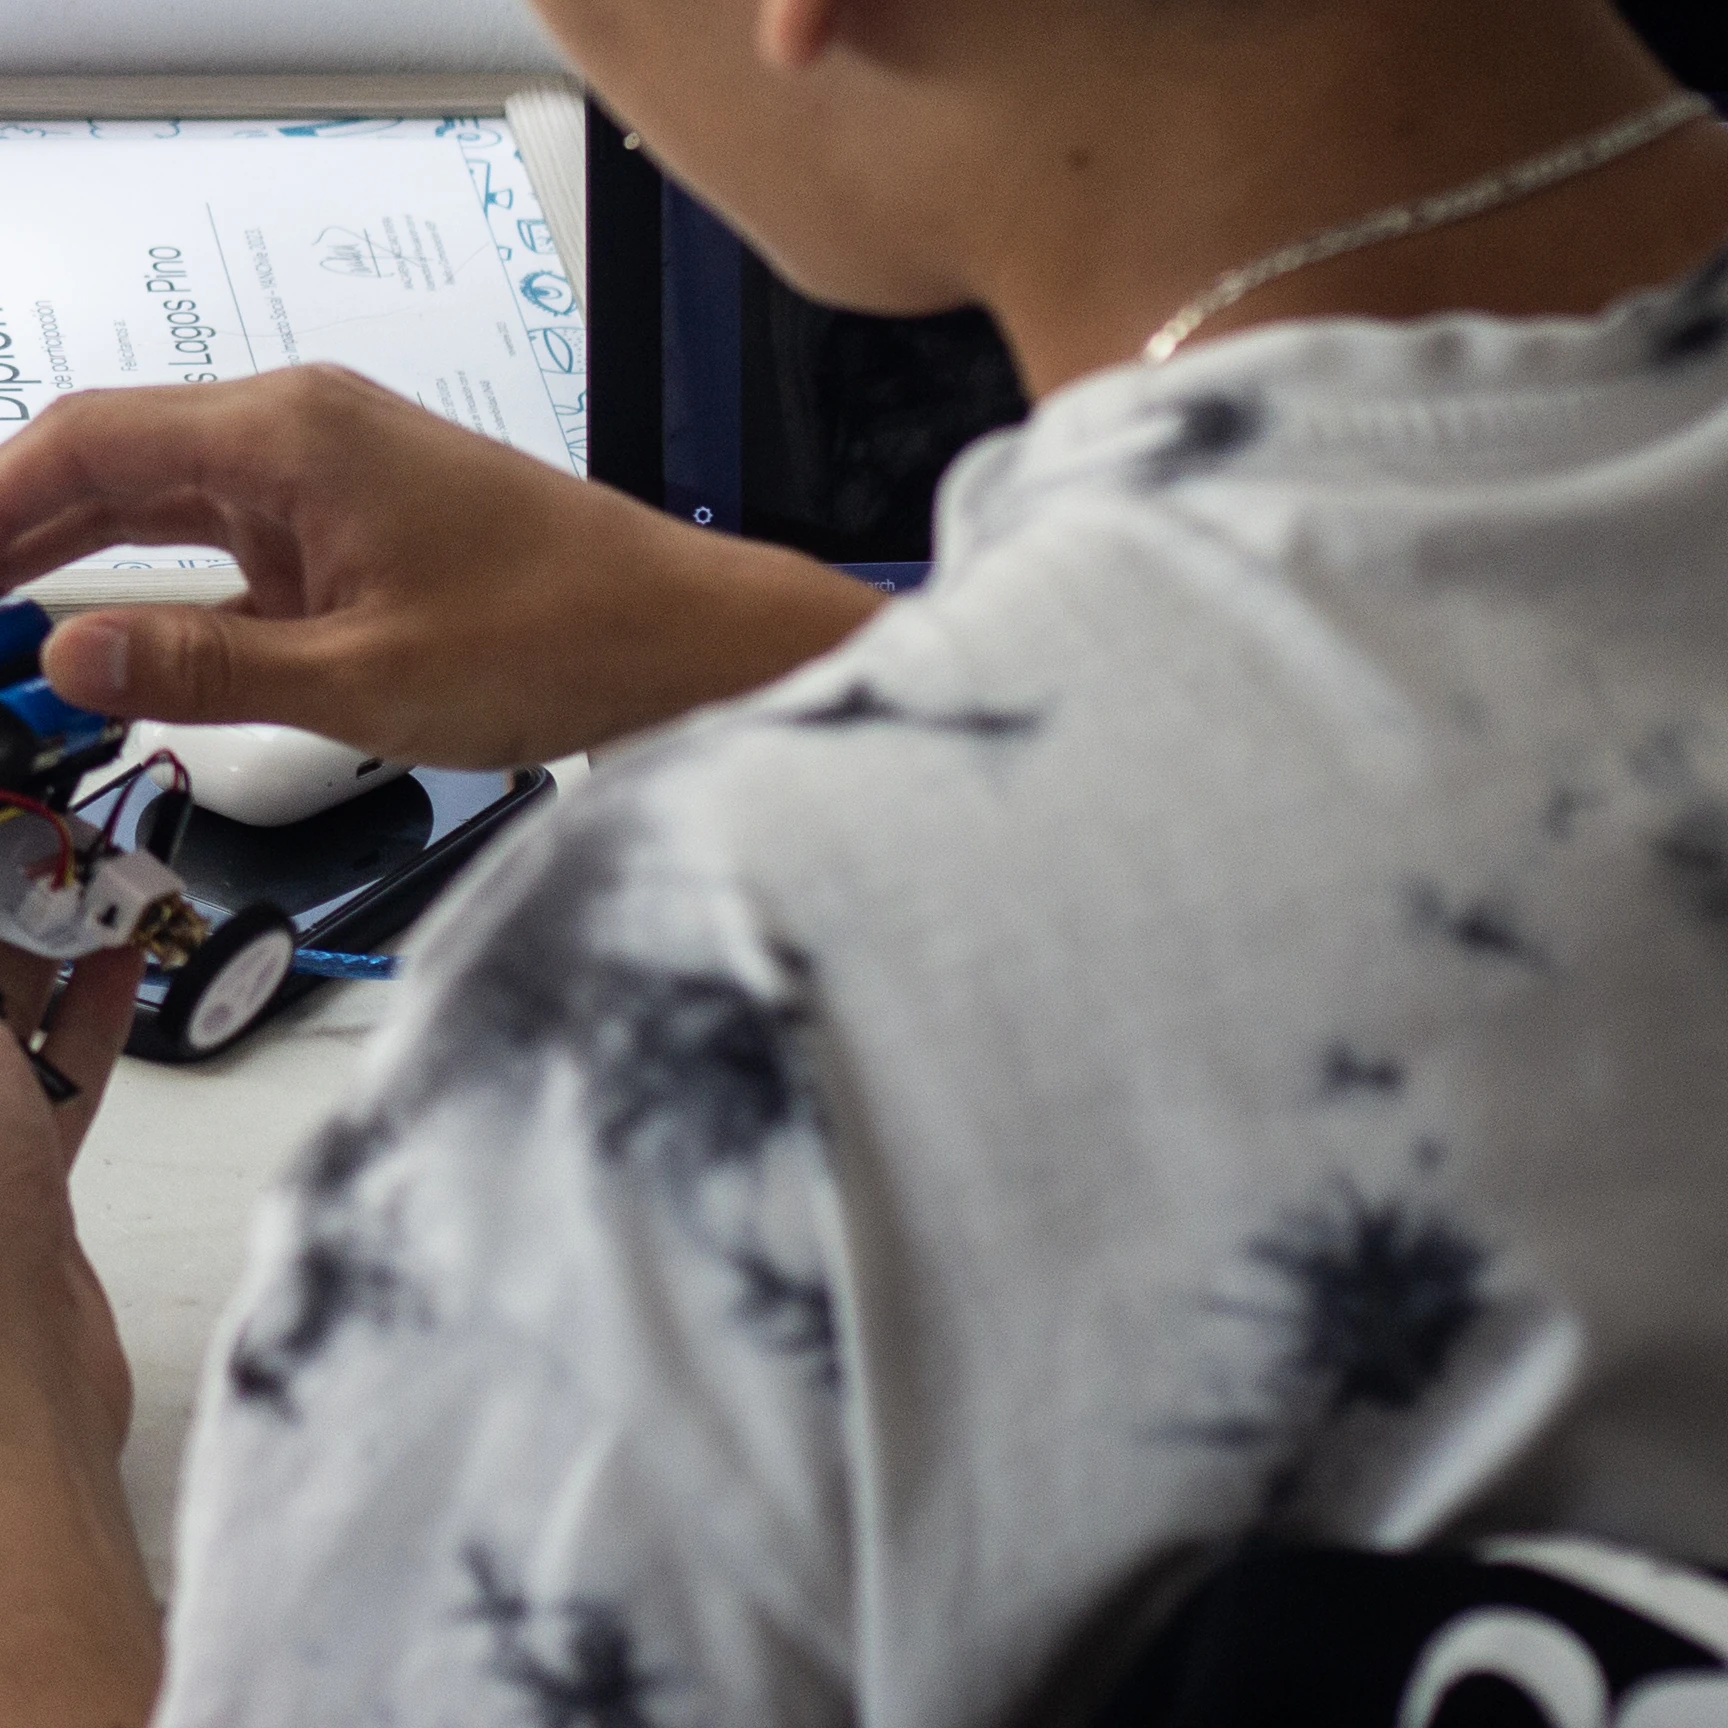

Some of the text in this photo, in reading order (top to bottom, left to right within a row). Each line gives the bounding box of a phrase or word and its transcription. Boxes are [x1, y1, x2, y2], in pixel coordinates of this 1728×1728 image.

[144, 245, 192, 294] Pino
[31, 299, 75, 390] de participación
[163, 299, 216, 366] Lagos
[867, 579, 896, 592] arch
